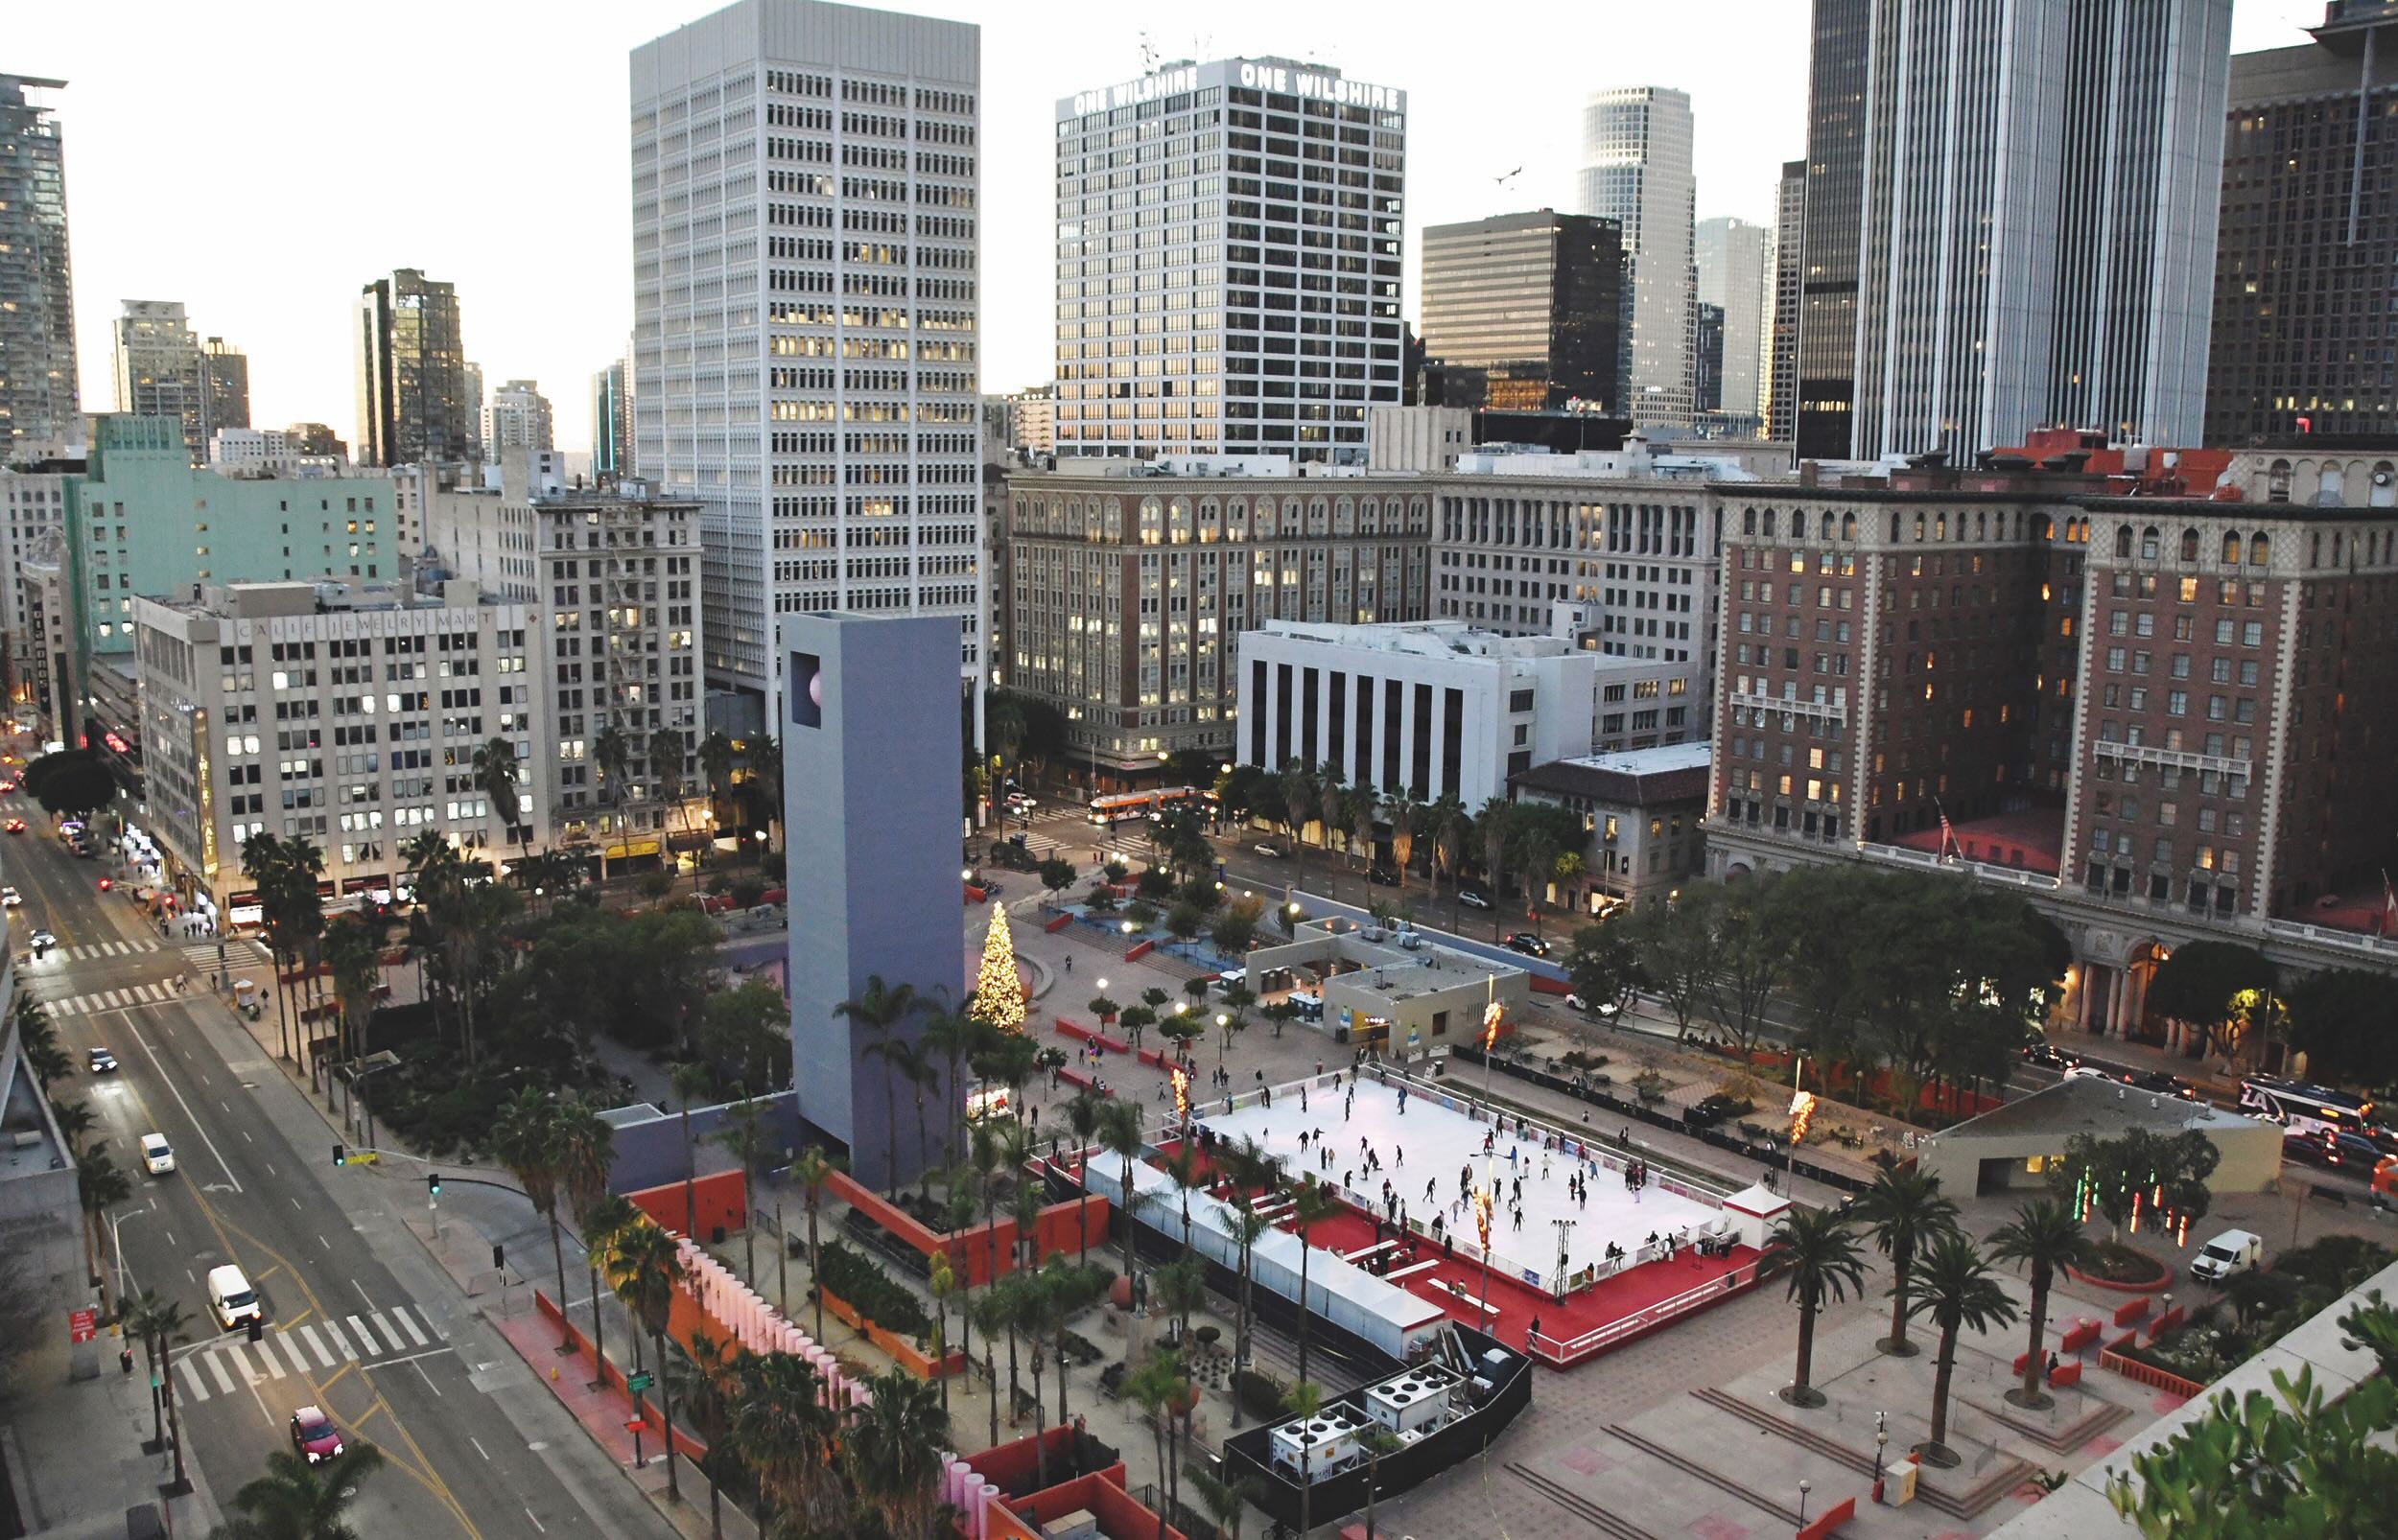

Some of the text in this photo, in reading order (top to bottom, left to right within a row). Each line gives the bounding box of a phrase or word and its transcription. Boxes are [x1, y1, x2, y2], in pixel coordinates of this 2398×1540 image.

[1074, 66, 1197, 116] ONE WILSHIRE
[1240, 63, 1398, 111] ONE WILSHIRE
[239, 613, 490, 638] CALIF JEWELRY MART
